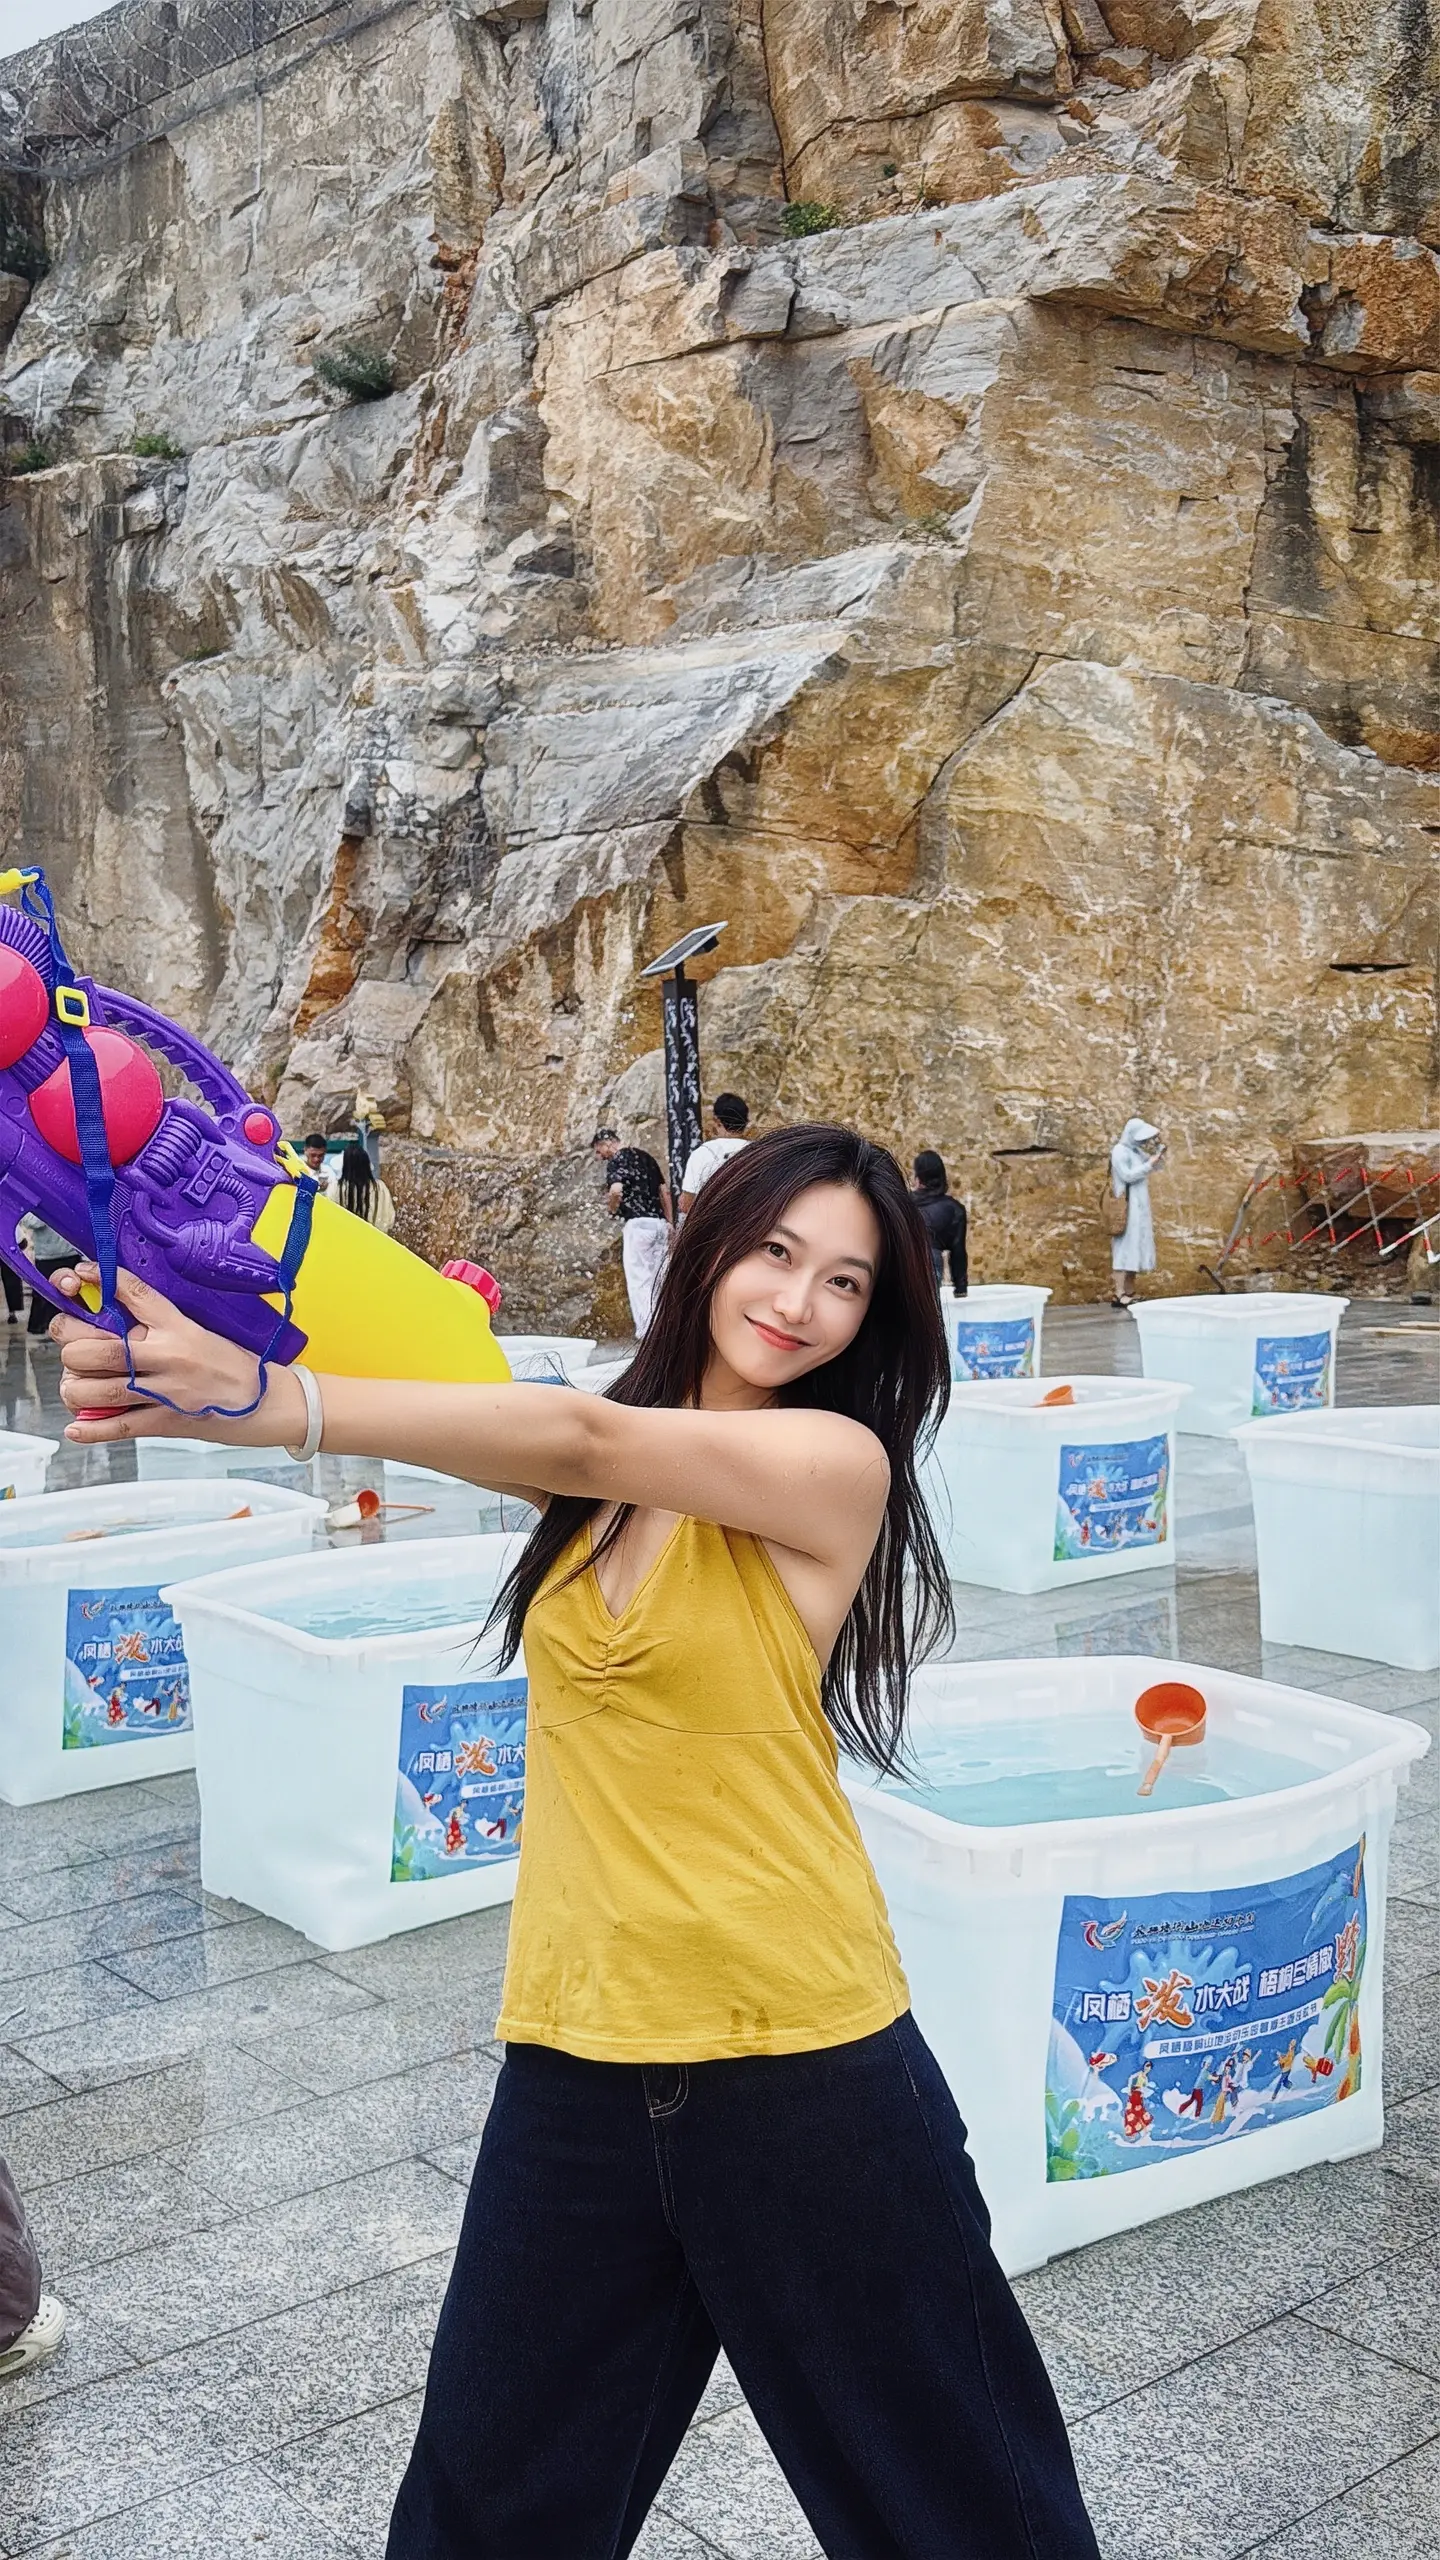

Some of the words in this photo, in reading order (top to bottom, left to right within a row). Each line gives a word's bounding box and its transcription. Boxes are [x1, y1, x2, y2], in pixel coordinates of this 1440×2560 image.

[1082, 1968, 1251, 2032] 凤栖泼水大战
[1258, 1910, 1362, 1997] 梧桐尽情撒野
